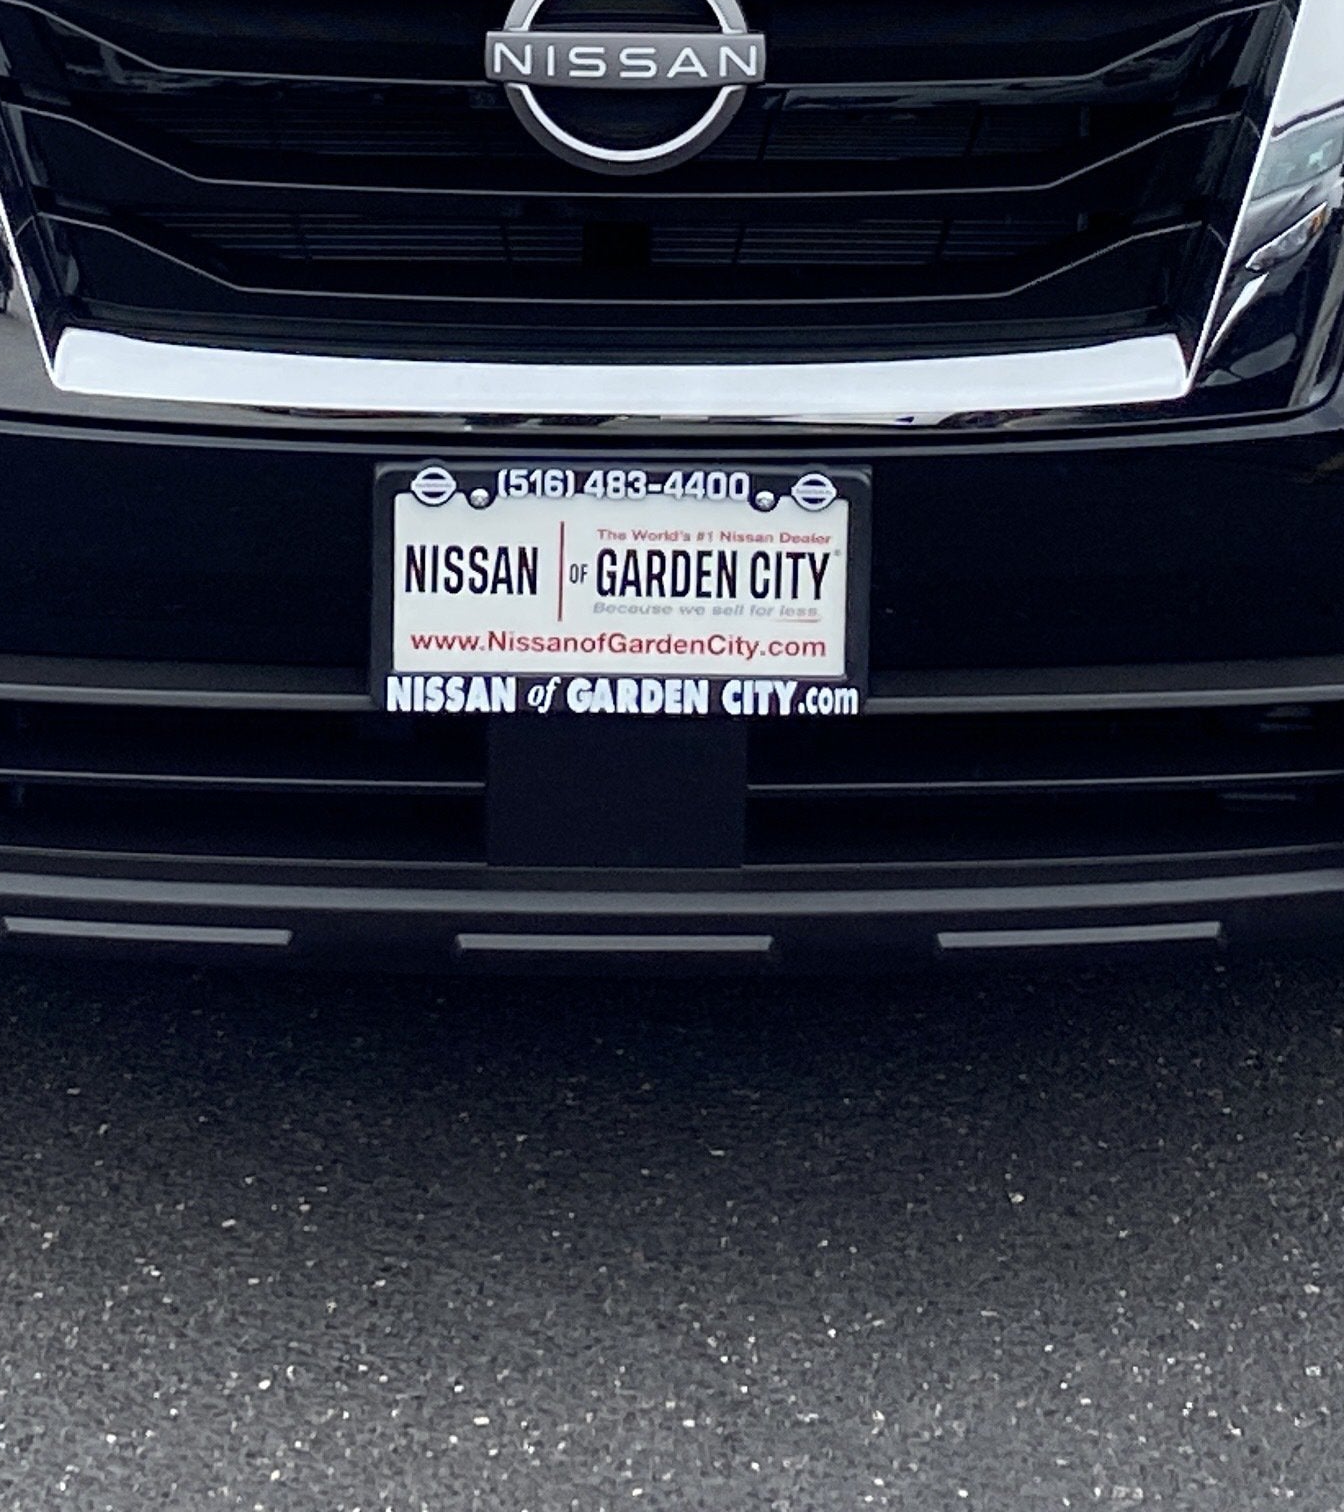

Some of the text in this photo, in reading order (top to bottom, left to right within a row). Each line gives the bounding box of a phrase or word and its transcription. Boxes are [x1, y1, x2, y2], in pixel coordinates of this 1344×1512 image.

[492, 42, 758, 78] NISSAN
[497, 468, 750, 501] (516) 483-4400
[597, 528, 832, 545] The World's #1 Nissan Dealer
[404, 544, 831, 601] NISSAN OF GARDEN CITY
[592, 601, 674, 616] Because
[678, 604, 707, 616] we
[712, 603, 745, 617] sell
[748, 604, 775, 618] for
[410, 631, 827, 661] www.NissanofGardenCity.com
[386, 675, 860, 716] NISSAN of GARDEN CITY.com
